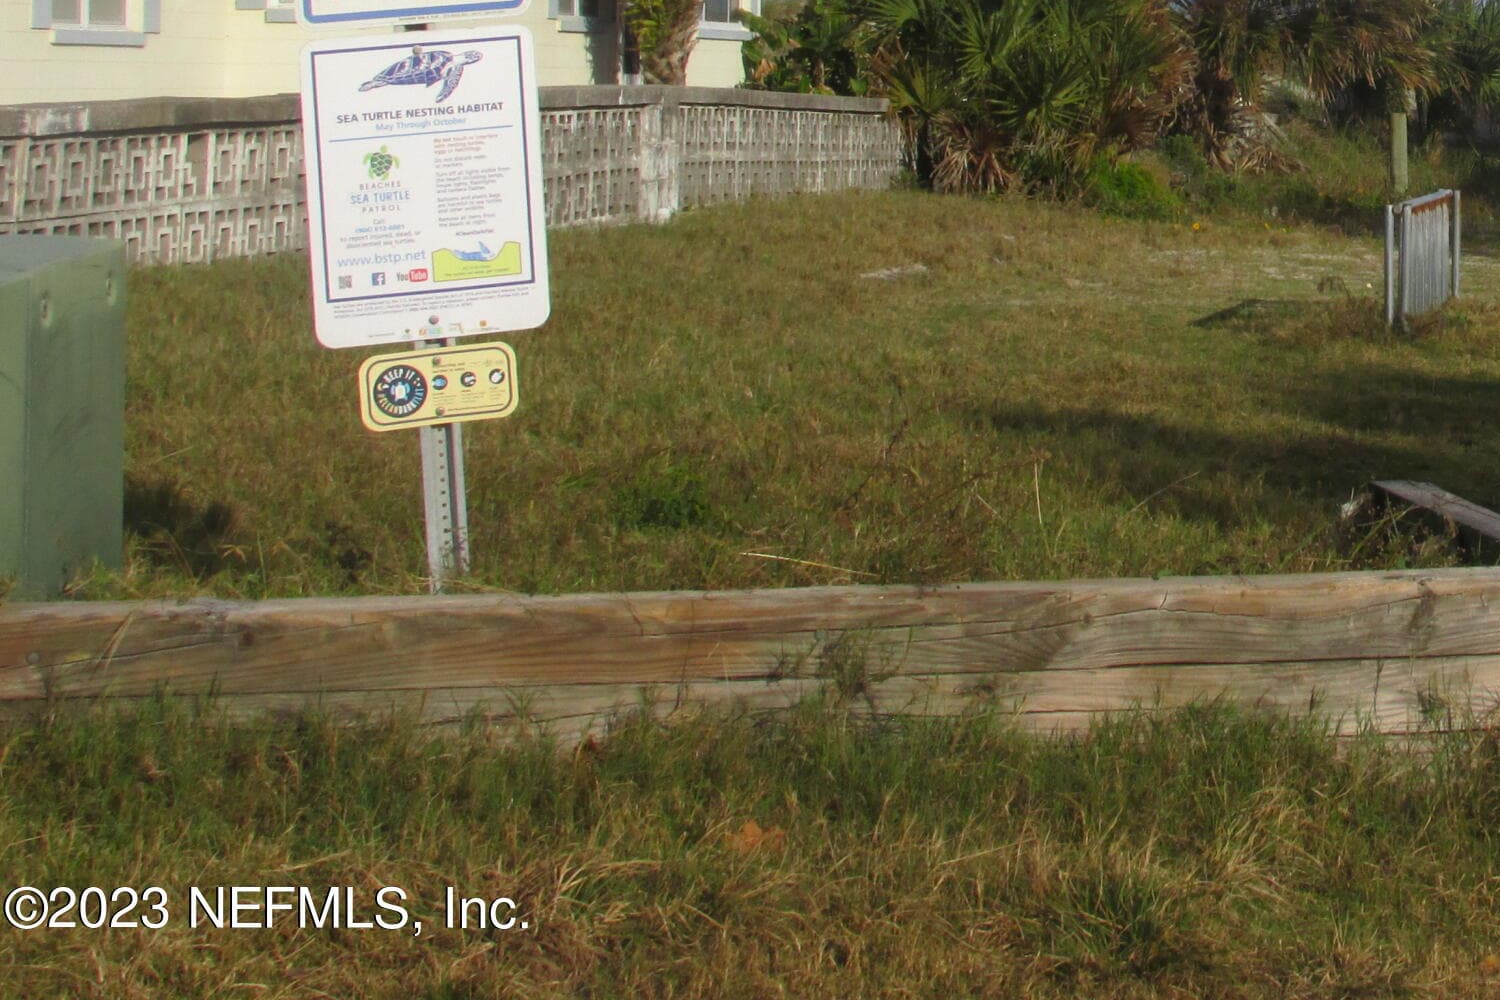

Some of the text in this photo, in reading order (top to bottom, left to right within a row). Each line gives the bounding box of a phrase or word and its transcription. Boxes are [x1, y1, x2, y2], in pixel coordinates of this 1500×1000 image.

[336, 102, 504, 124] SEA TURTLE NESTING HABITAT
[375, 117, 466, 132] May Through October
[360, 181, 400, 190] BEACHES
[350, 191, 410, 202] SEA TURTLE
[337, 250, 425, 267] www.bstp.net
